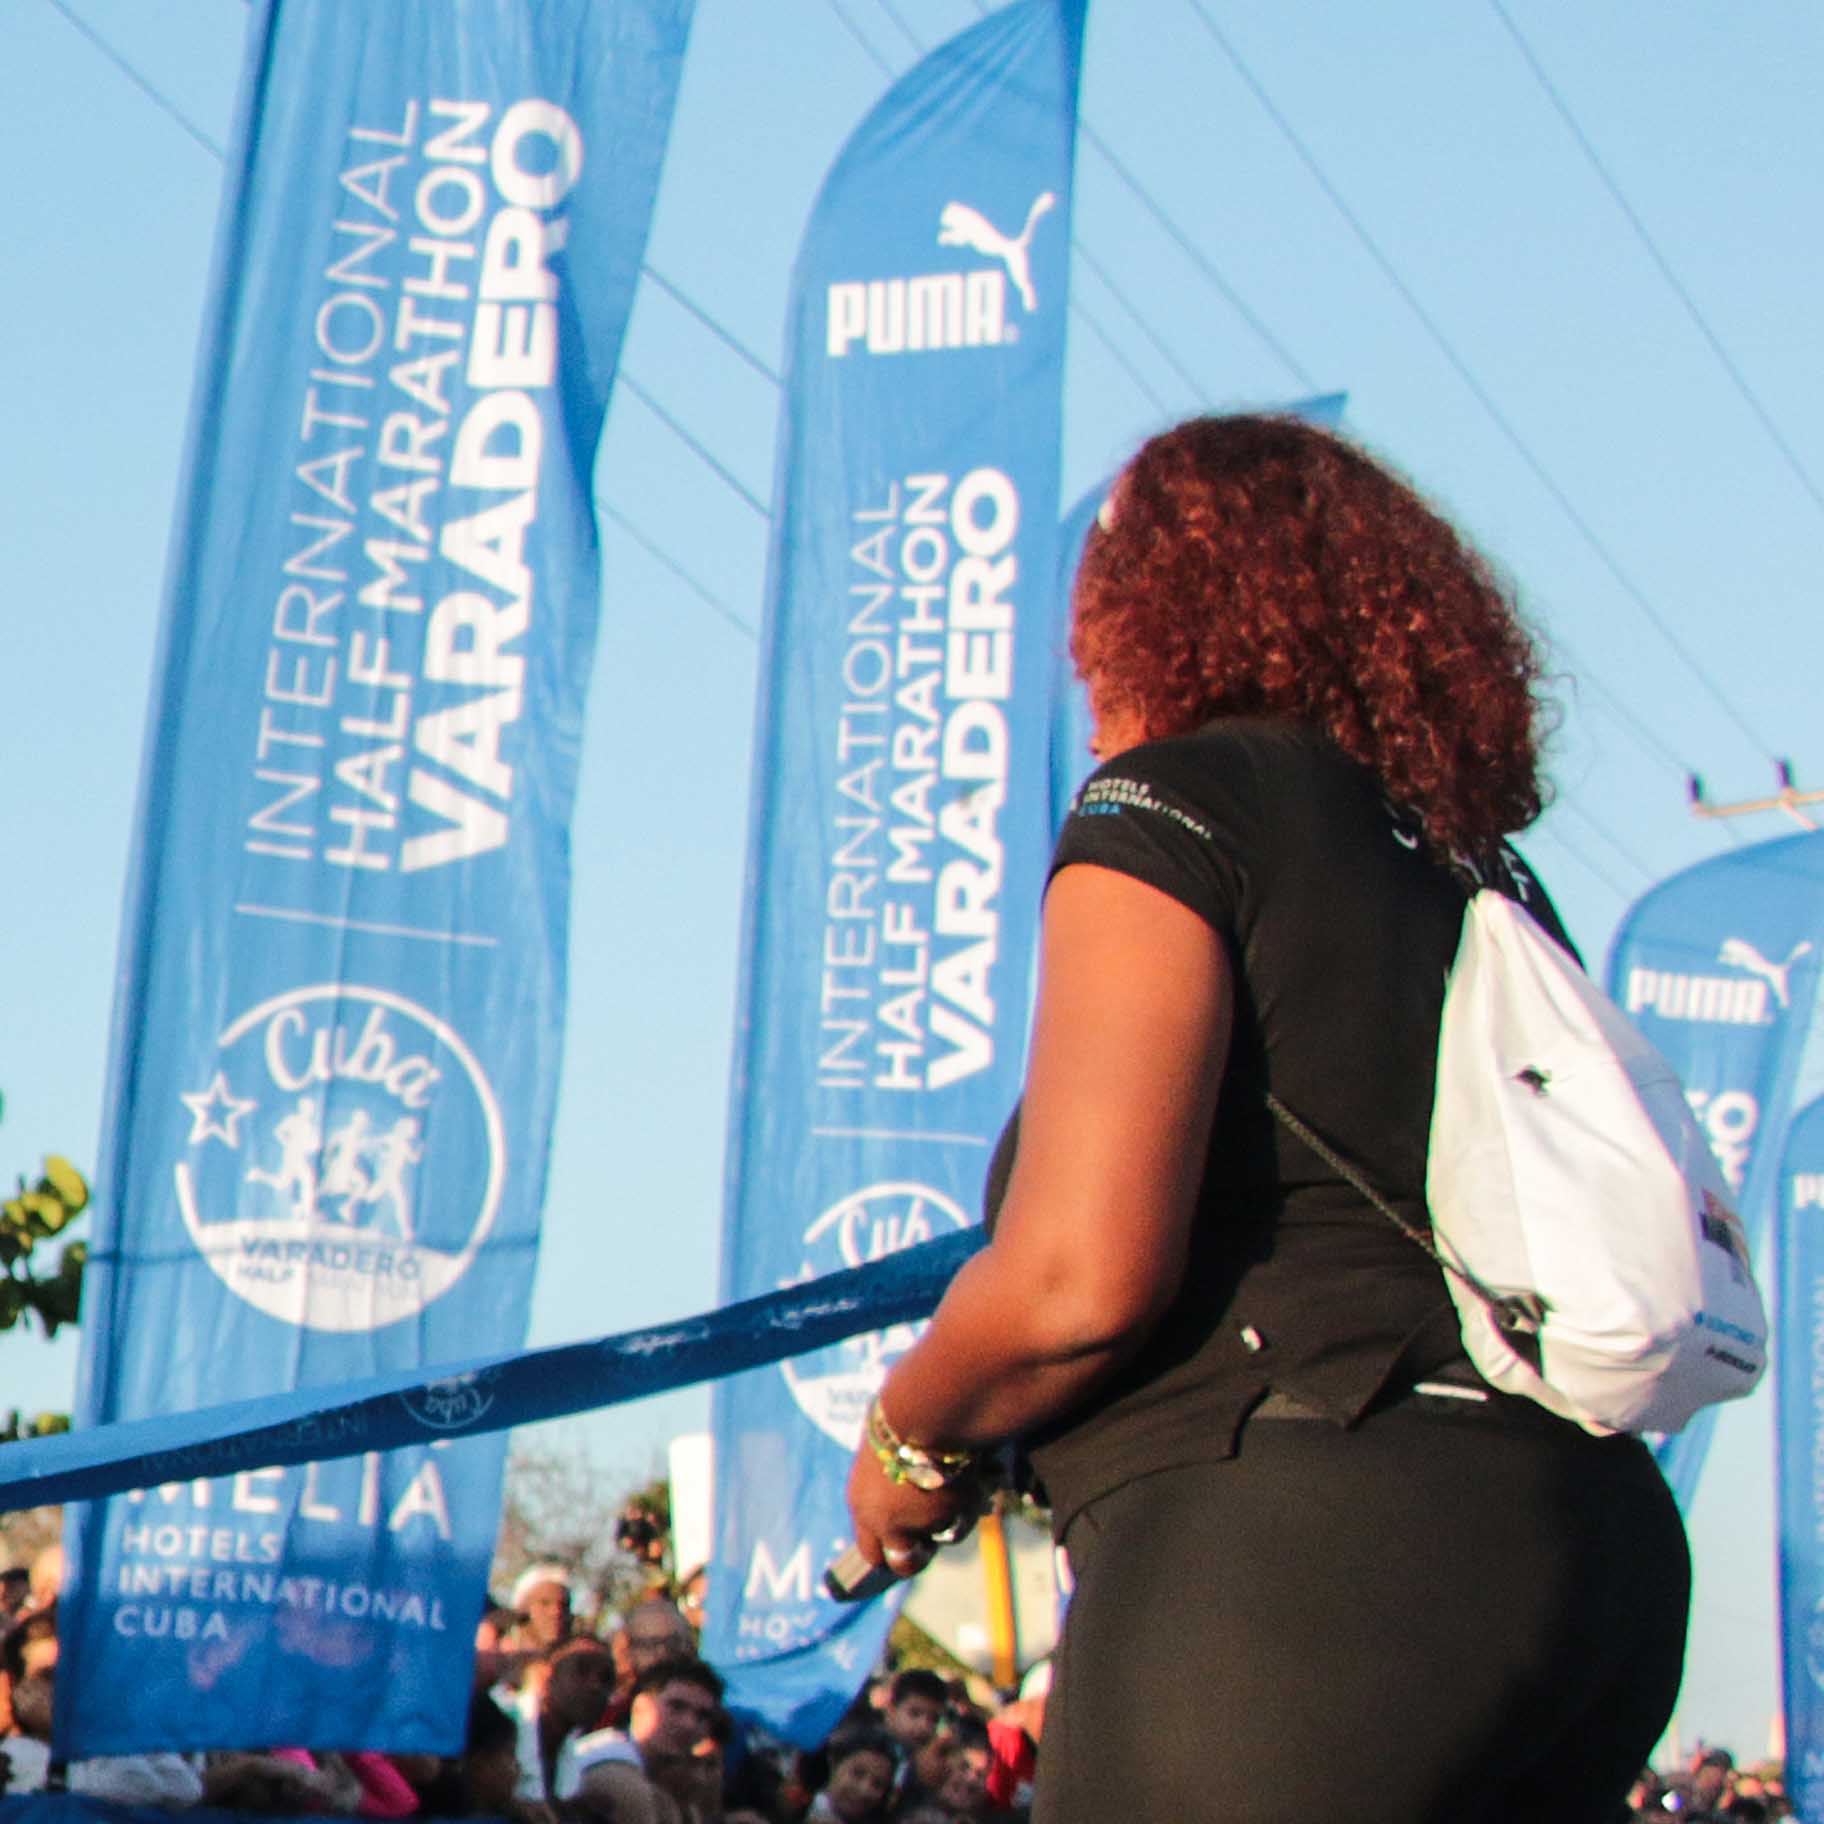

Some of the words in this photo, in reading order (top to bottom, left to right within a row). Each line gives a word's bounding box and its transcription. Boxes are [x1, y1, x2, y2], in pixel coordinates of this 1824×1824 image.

[357, 97, 492, 613] MARATHON
[827, 270, 1005, 357] PUMA
[245, 98, 419, 862] INTERNATIONAL
[399, 97, 584, 874] VARADERO
[324, 636, 412, 871] HALF
[882, 473, 949, 884] MARATHON
[817, 480, 901, 1088] INTERNATIONAL
[927, 466, 1019, 1092] VARADERO
[262, 1006, 442, 1110] Cuba
[874, 903, 934, 1093] HALF
[1626, 967, 1768, 1025] PUMA
[242, 1236, 420, 1281] VARADERO
[113, 1606, 228, 1640] CUBA
[117, 1564, 446, 1631] INTERNATIONAL
[122, 1524, 282, 1563] HOTELS
